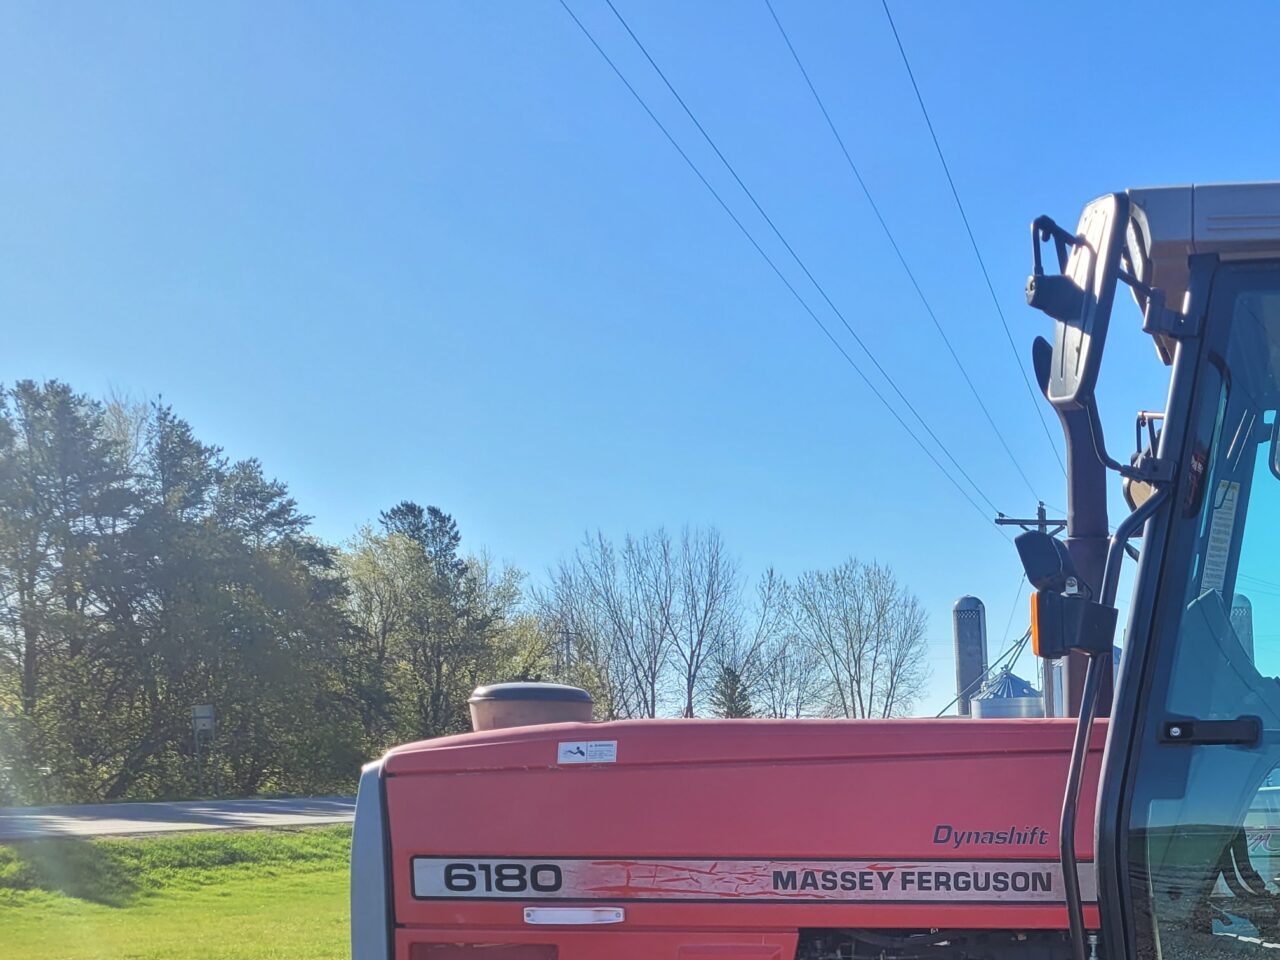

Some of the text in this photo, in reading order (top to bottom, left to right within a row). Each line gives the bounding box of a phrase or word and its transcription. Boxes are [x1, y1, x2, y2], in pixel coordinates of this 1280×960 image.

[933, 825, 1049, 849] Dynashift
[444, 863, 563, 893] 6180
[772, 870, 1052, 892] MASSEY FERGUSON
